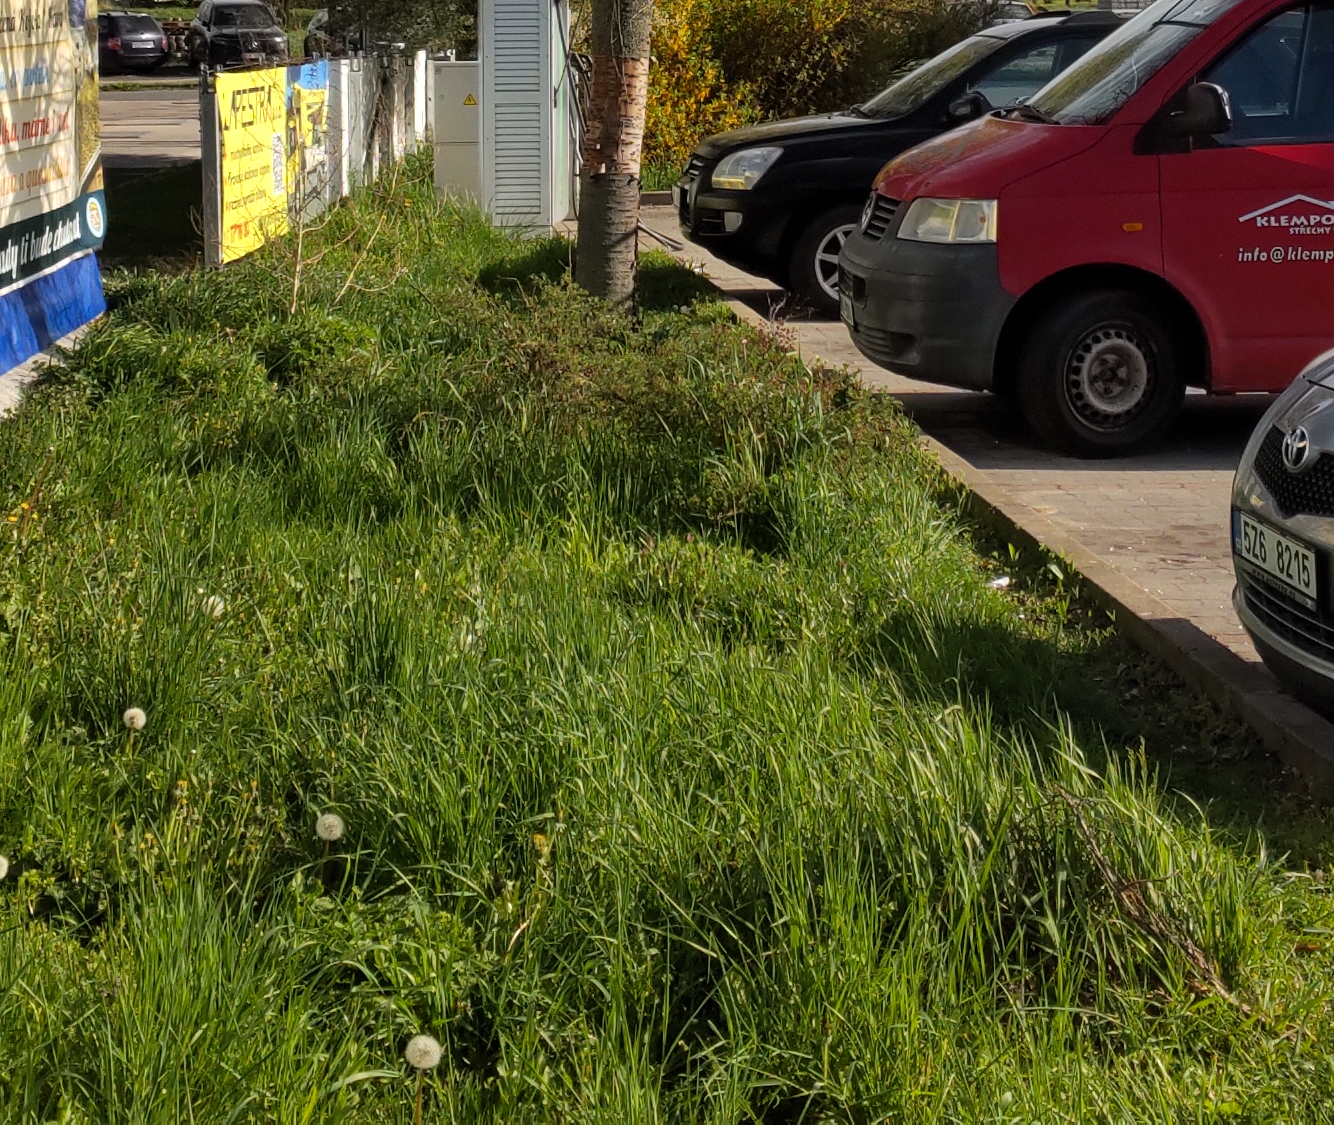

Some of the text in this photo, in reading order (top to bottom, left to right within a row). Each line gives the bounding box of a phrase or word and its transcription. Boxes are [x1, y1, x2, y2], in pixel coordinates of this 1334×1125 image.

[20, 233, 28, 265] ti
[30, 225, 52, 260] bude
[1289, 224, 1330, 235] STŘECHY
[1243, 520, 1267, 564] 5Z6
[1276, 539, 1310, 589] 8215
